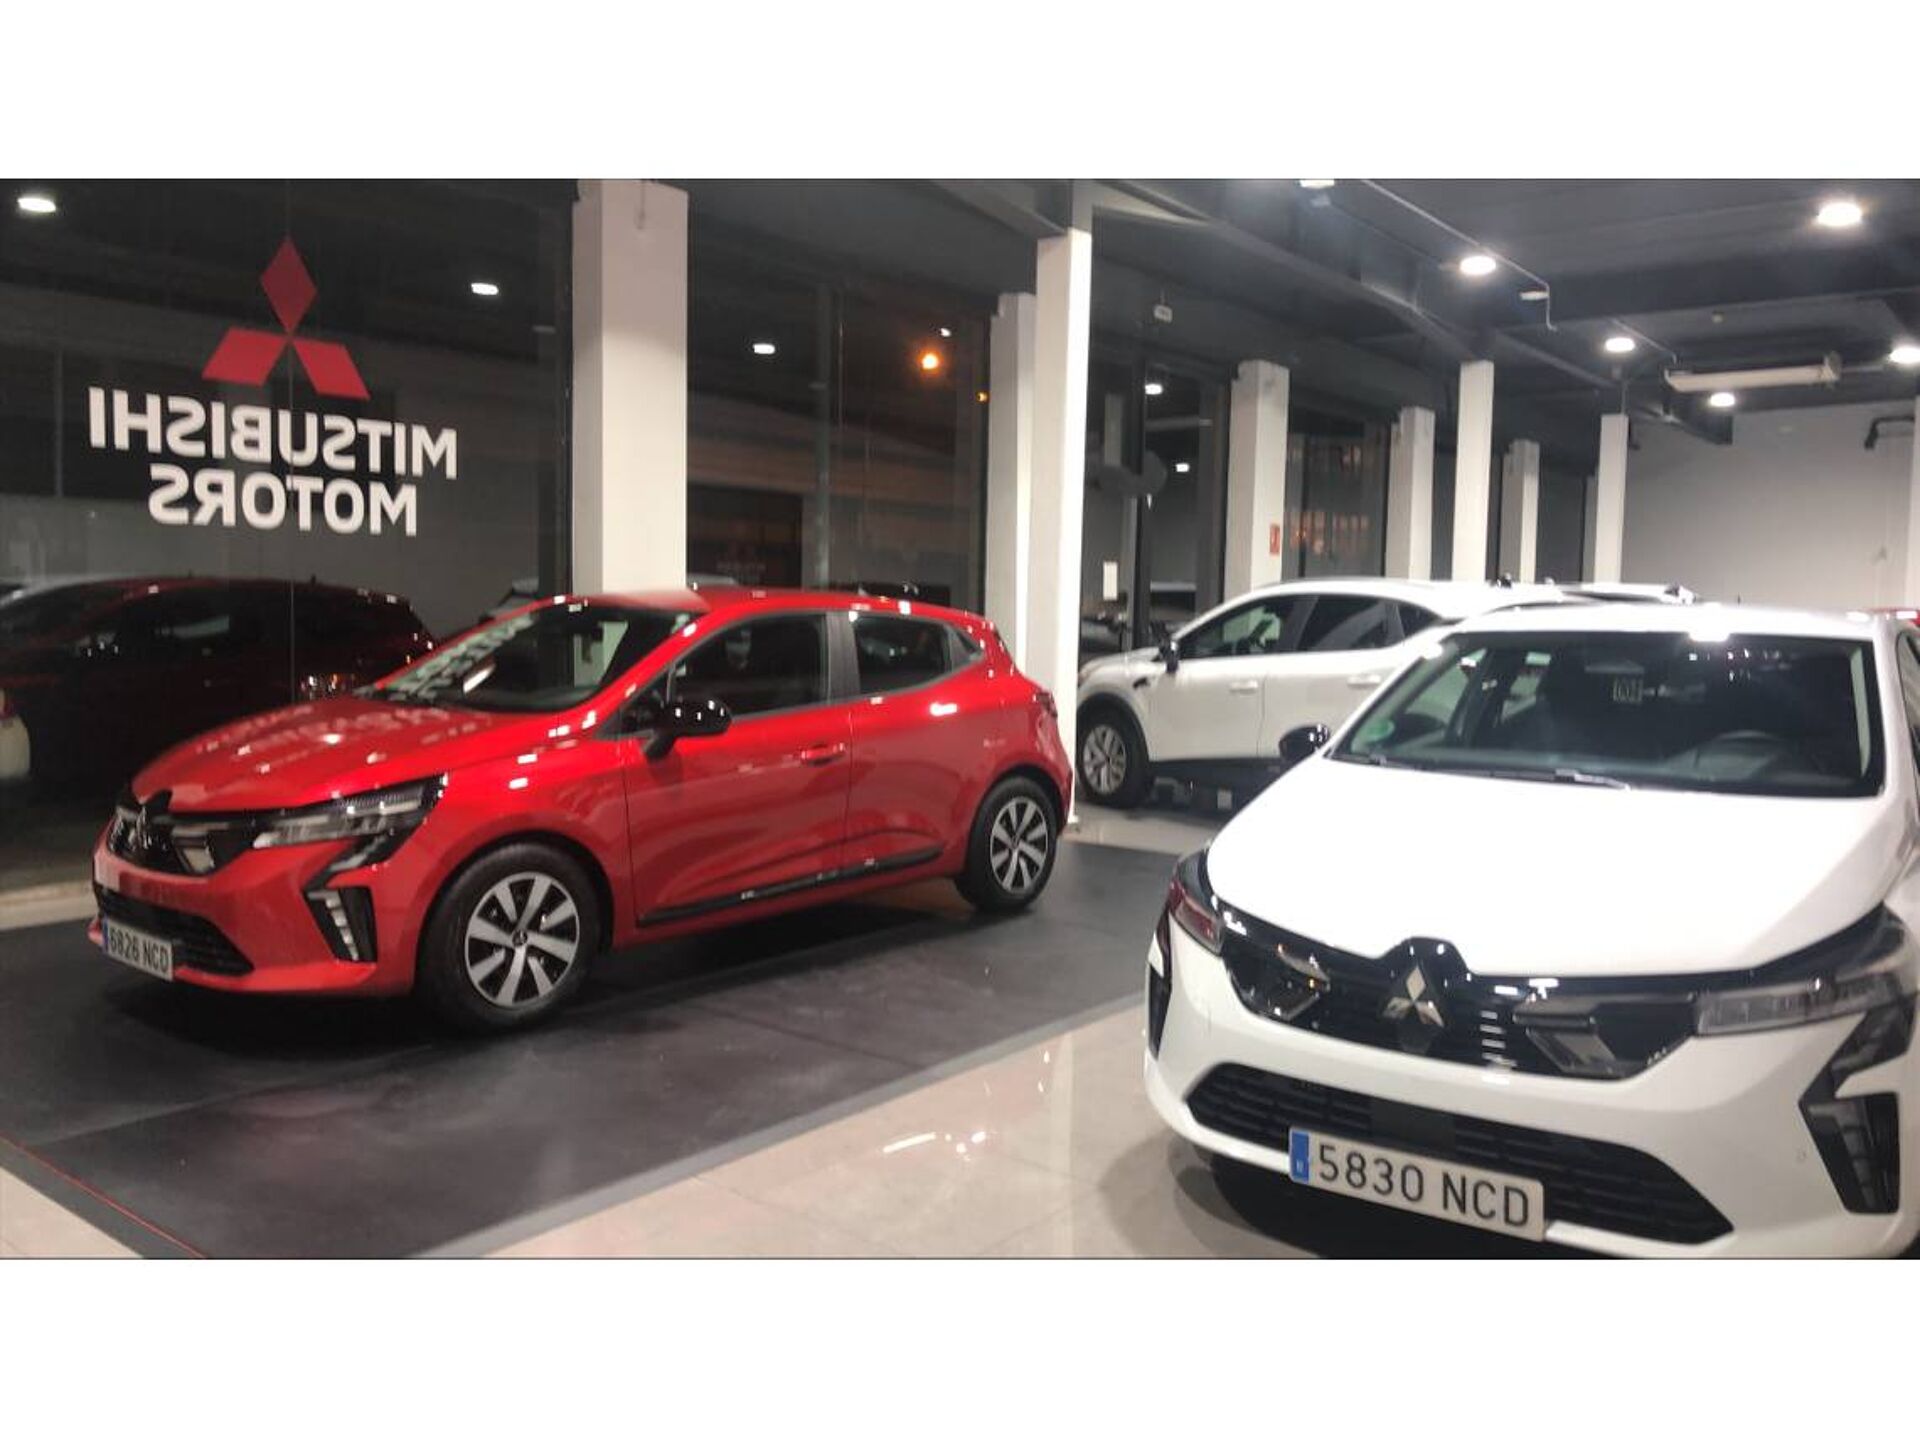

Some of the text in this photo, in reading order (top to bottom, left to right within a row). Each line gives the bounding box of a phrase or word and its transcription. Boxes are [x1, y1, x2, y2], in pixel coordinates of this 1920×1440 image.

[142, 939, 169, 973] NCD
[1318, 1144, 1529, 1227] 5830 NCD
